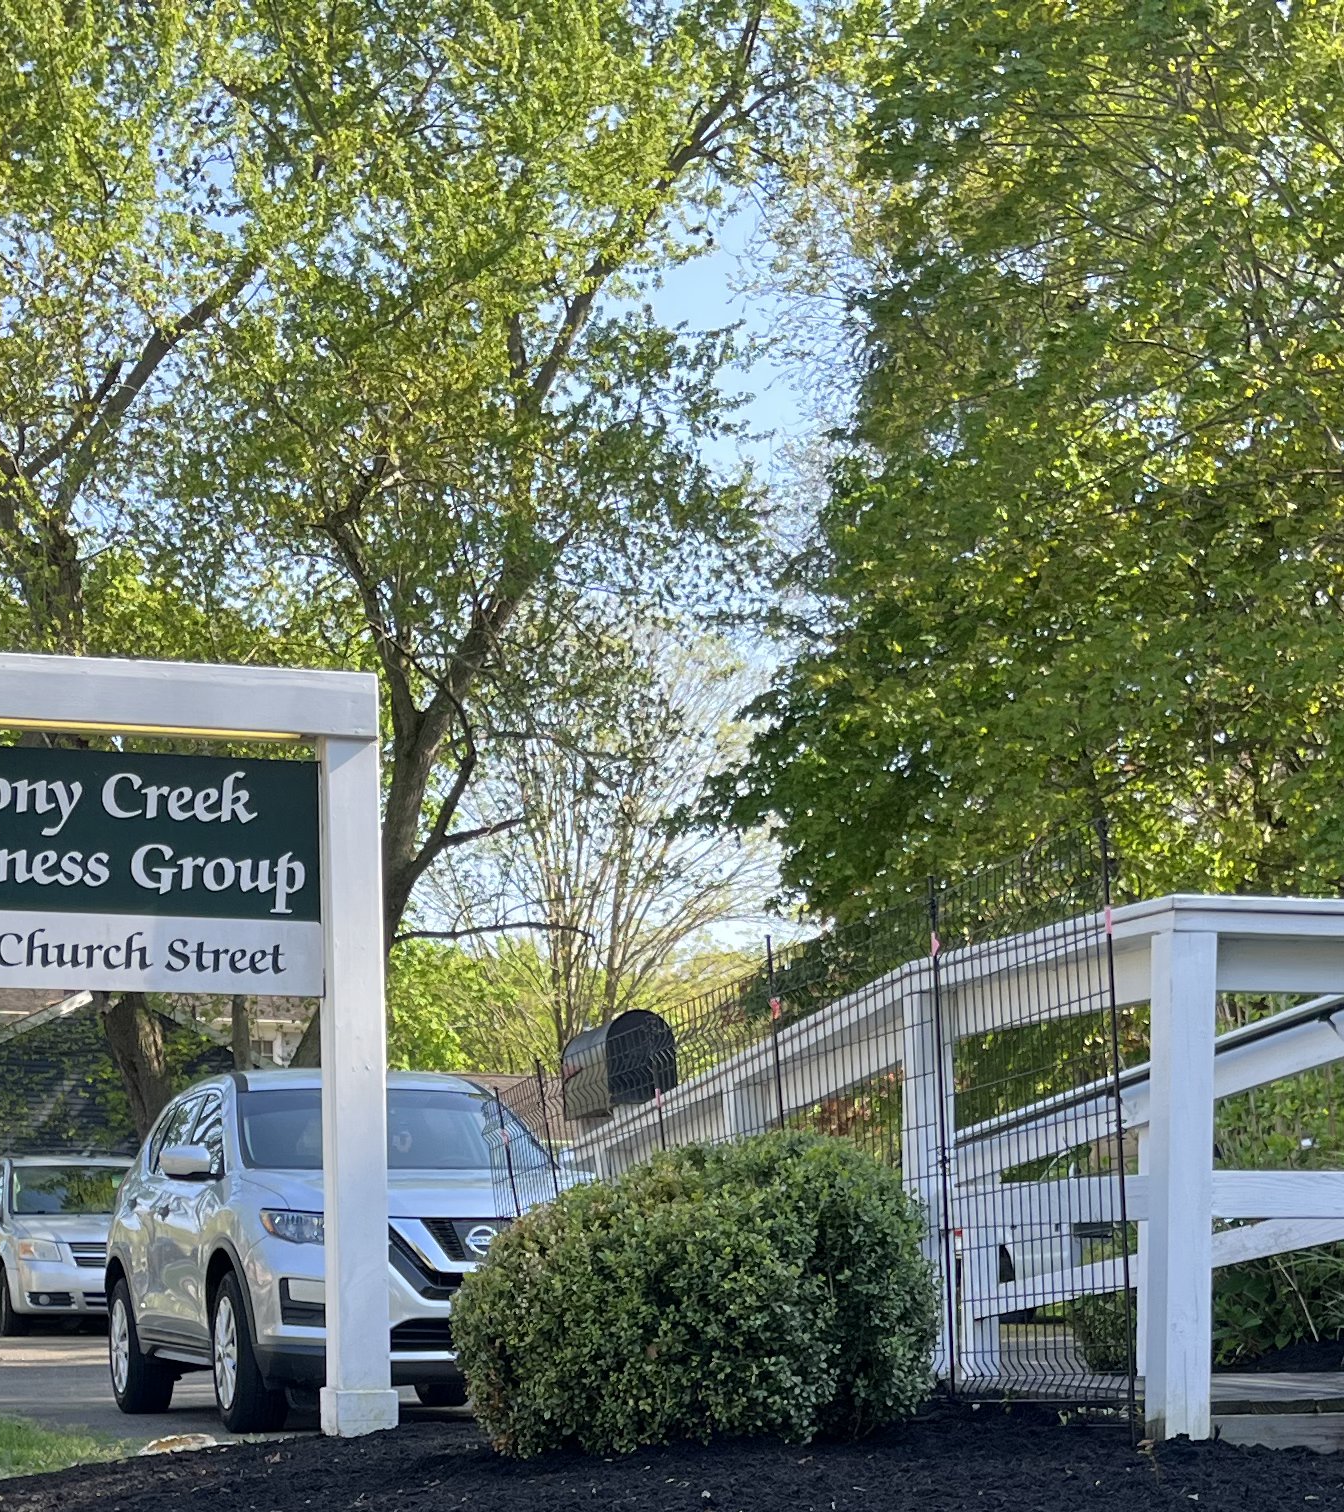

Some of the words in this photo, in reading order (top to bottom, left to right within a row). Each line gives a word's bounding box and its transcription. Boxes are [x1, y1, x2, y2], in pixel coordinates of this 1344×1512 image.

[101, 771, 258, 824] Creek
[130, 843, 306, 914] Group
[164, 938, 287, 976] Street
